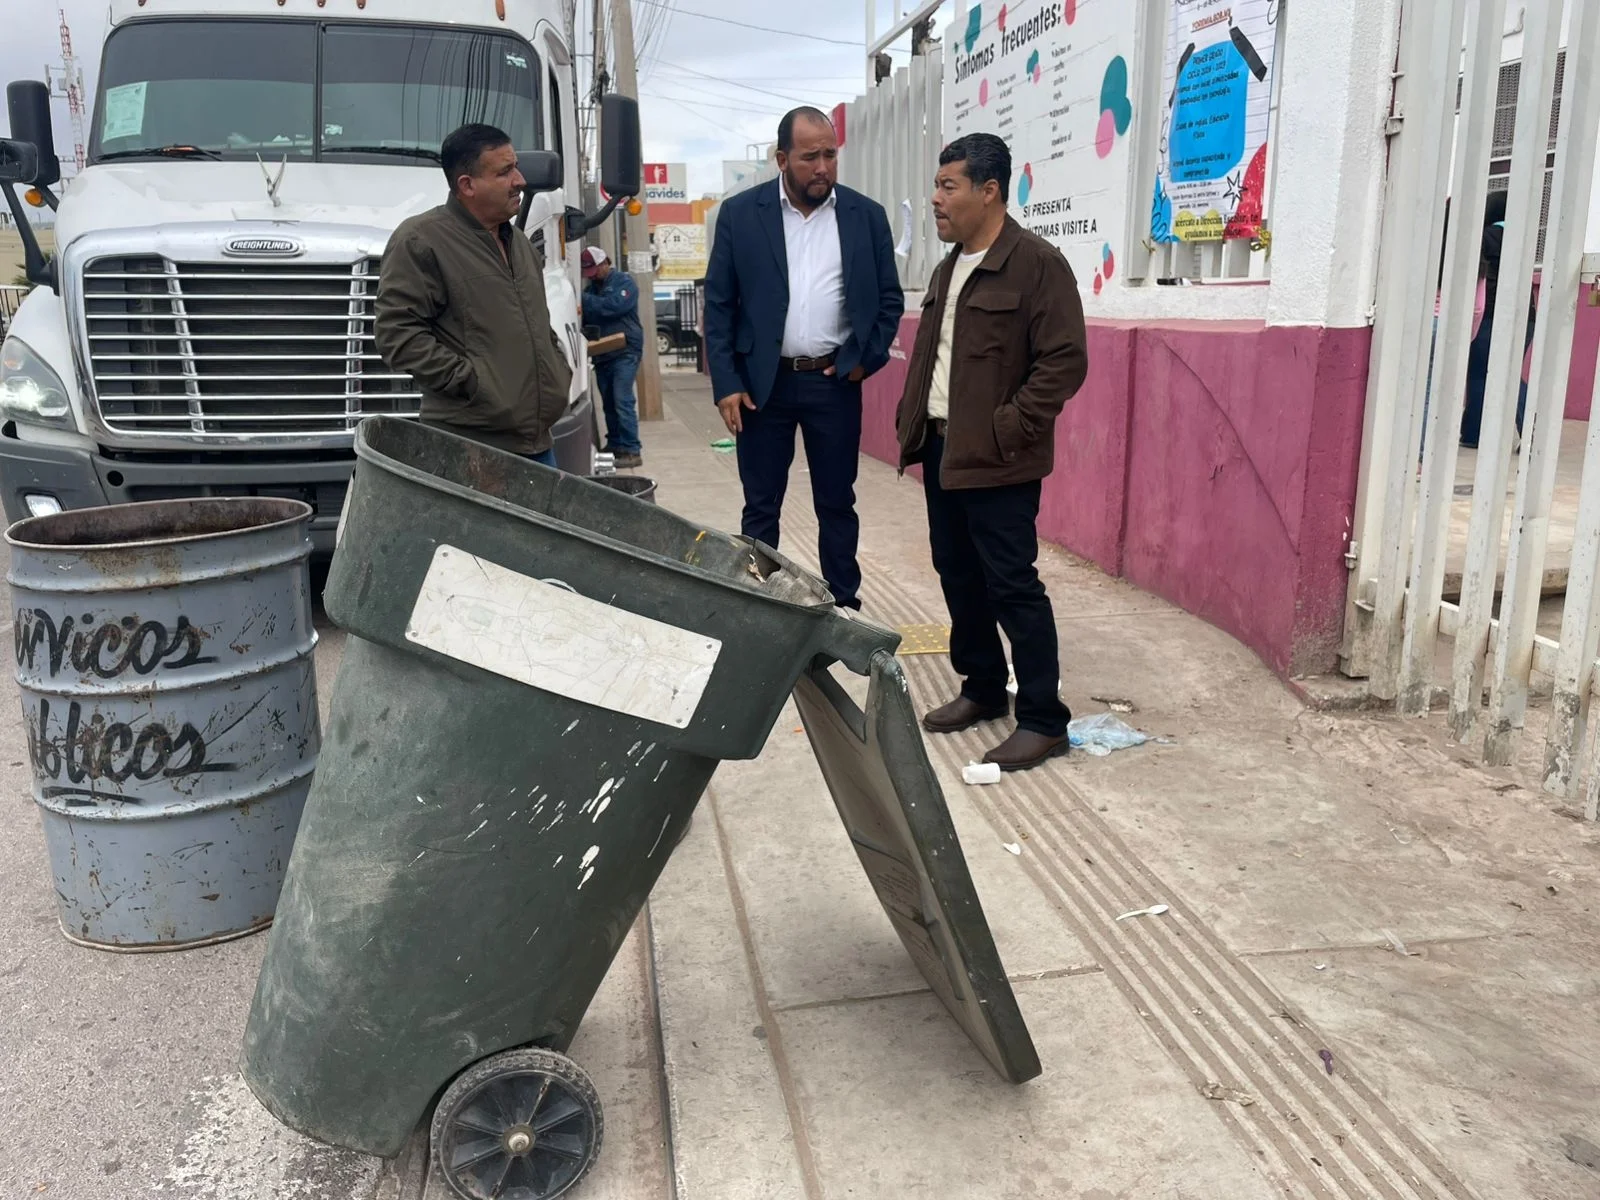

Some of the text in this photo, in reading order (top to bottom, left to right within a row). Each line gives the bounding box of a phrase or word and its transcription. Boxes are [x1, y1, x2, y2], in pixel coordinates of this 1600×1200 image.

[955, 4, 1061, 84] Síntomas frecuentes:
[646, 187, 685, 198] avides
[1023, 197, 1071, 217] SI PRESENTA
[1062, 219, 1088, 235] VISITE
[1091, 218, 1097, 233] A
[232, 241, 291, 250] FREIGHTLINER
